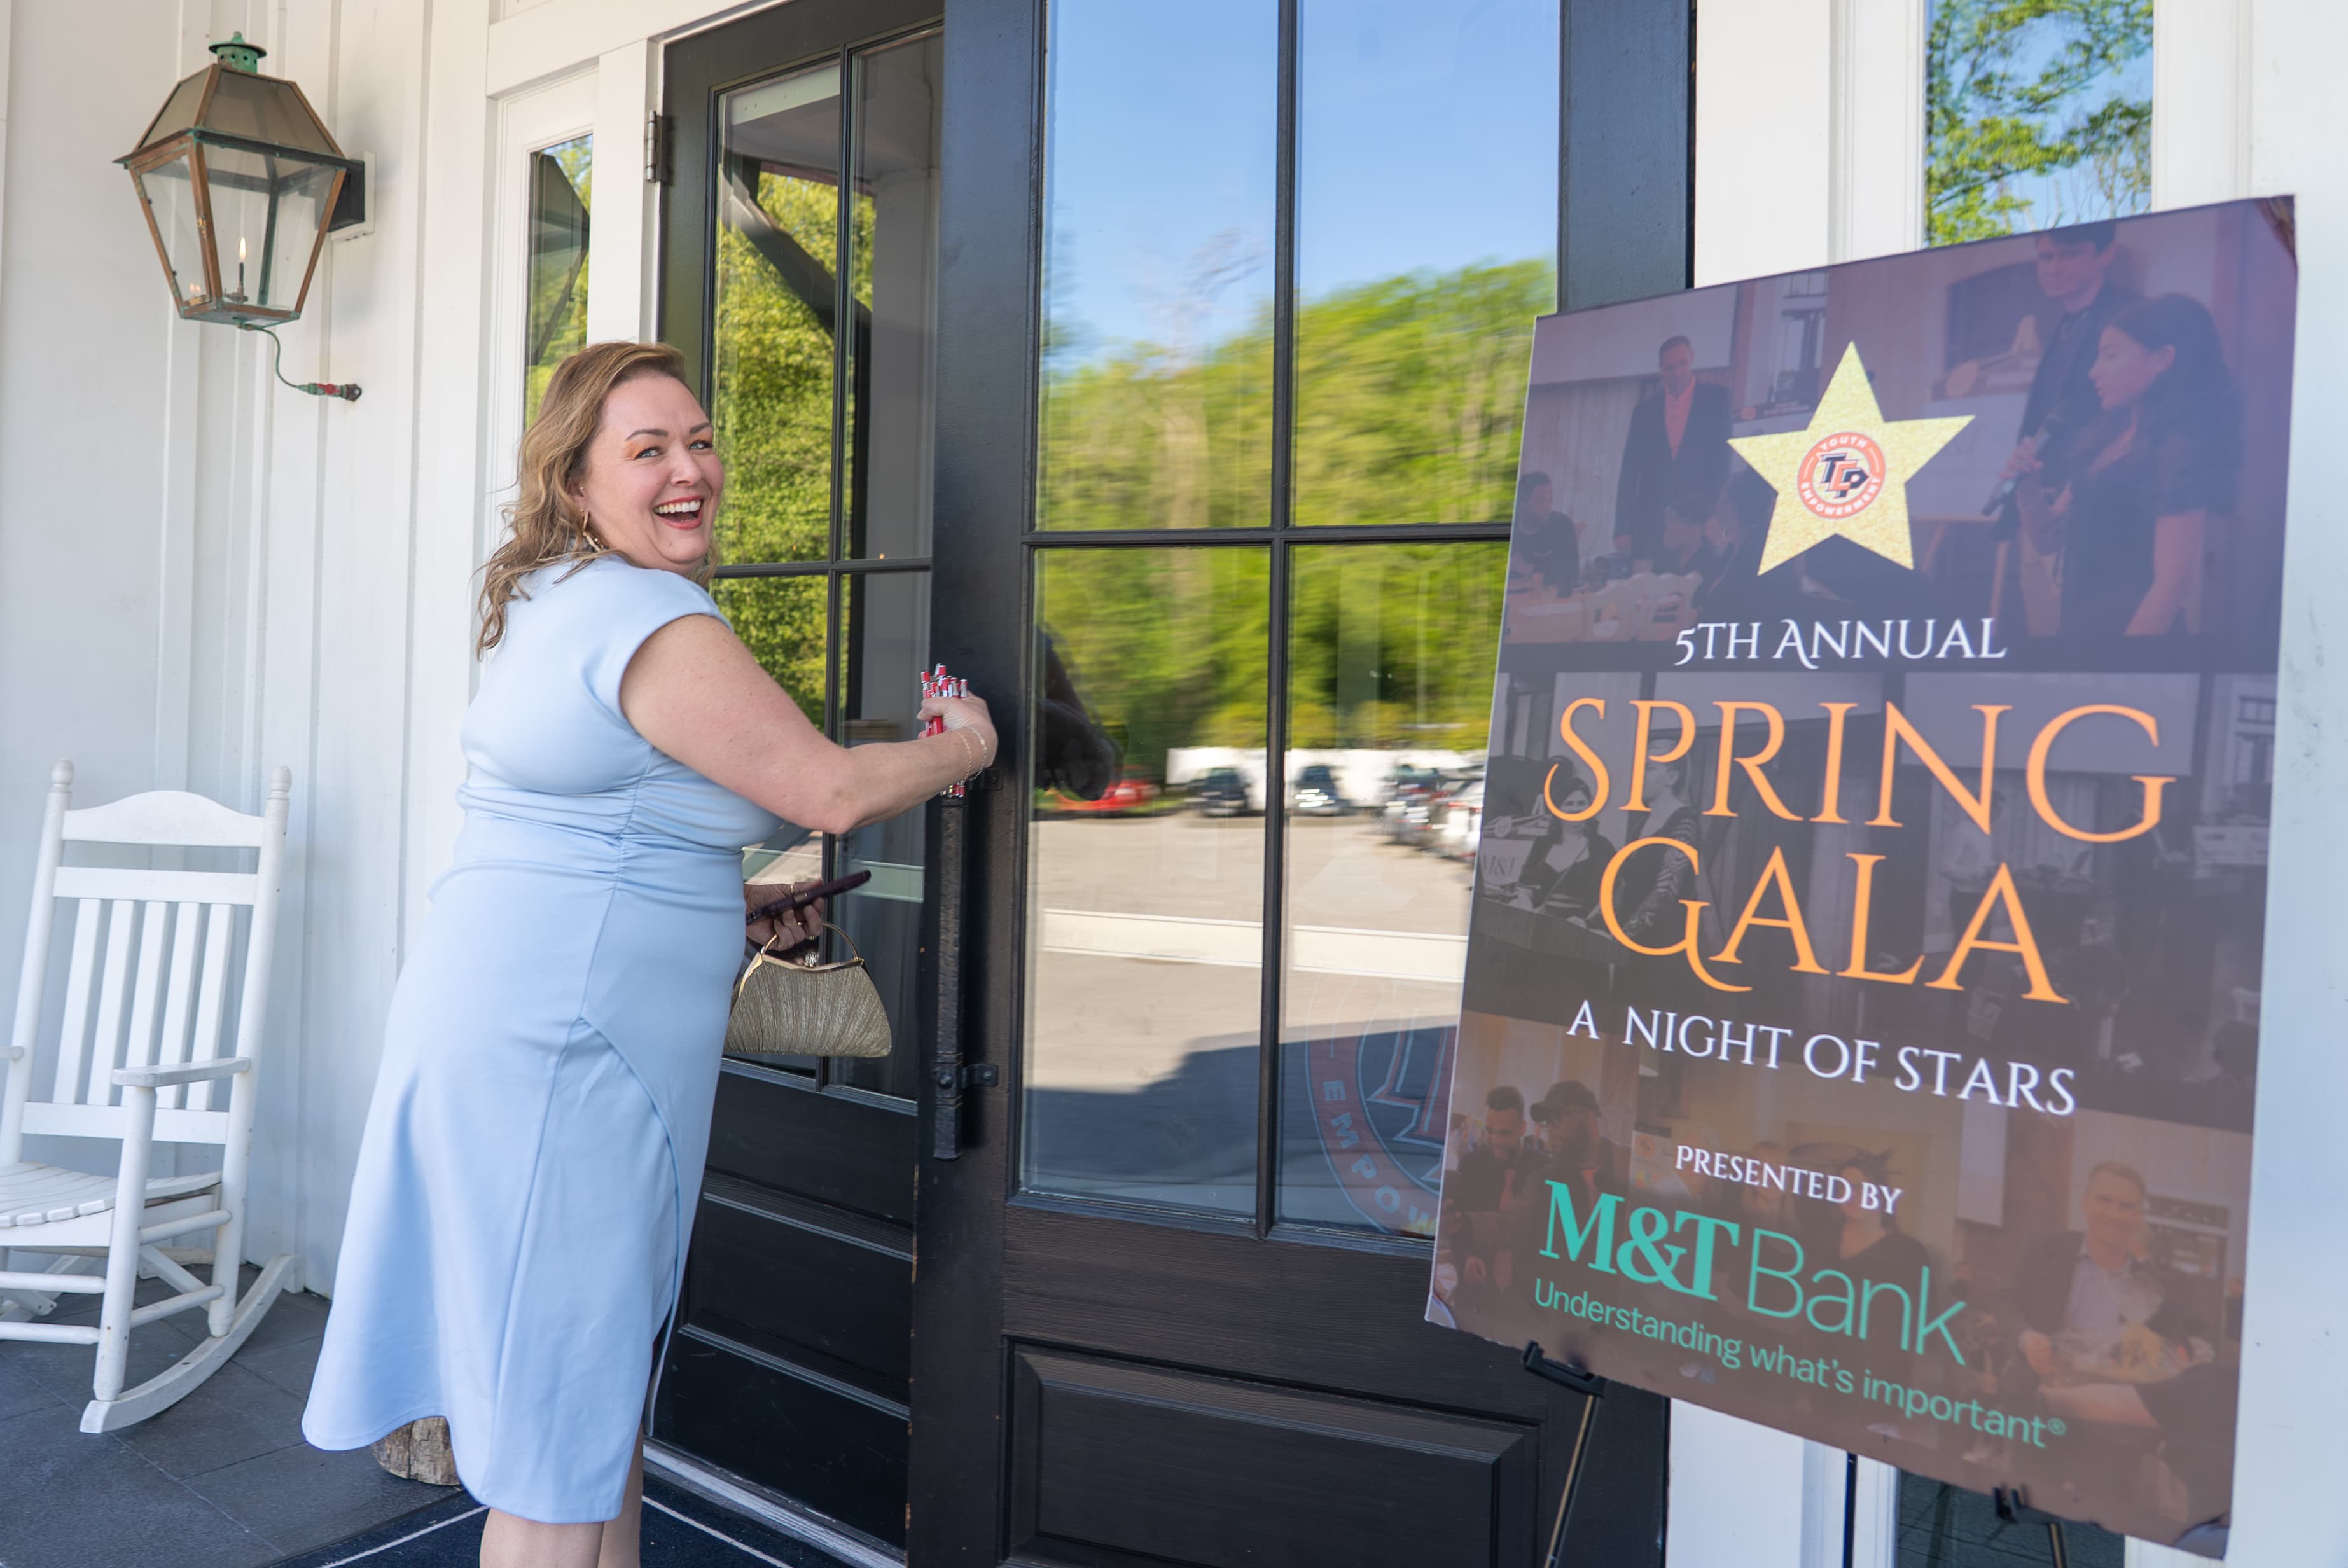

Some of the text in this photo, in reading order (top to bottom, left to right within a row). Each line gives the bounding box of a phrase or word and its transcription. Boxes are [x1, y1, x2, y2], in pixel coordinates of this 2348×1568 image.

[1801, 478, 1880, 515] EMPOWERMENT
[1819, 436, 1868, 450] YOUTH
[1674, 617, 2008, 670] 5TH ANNUAL
[1544, 697, 2176, 842] SPRING
[1599, 836, 2070, 1004] GALA
[1566, 999, 2076, 1116] A NIGHT OF STARS
[1674, 1144, 1903, 1214] PRESENTED BY
[1539, 1179, 1968, 1366] M&T Bank
[1534, 1277, 1743, 1370] Understanding
[1749, 1344, 1854, 1394] what's
